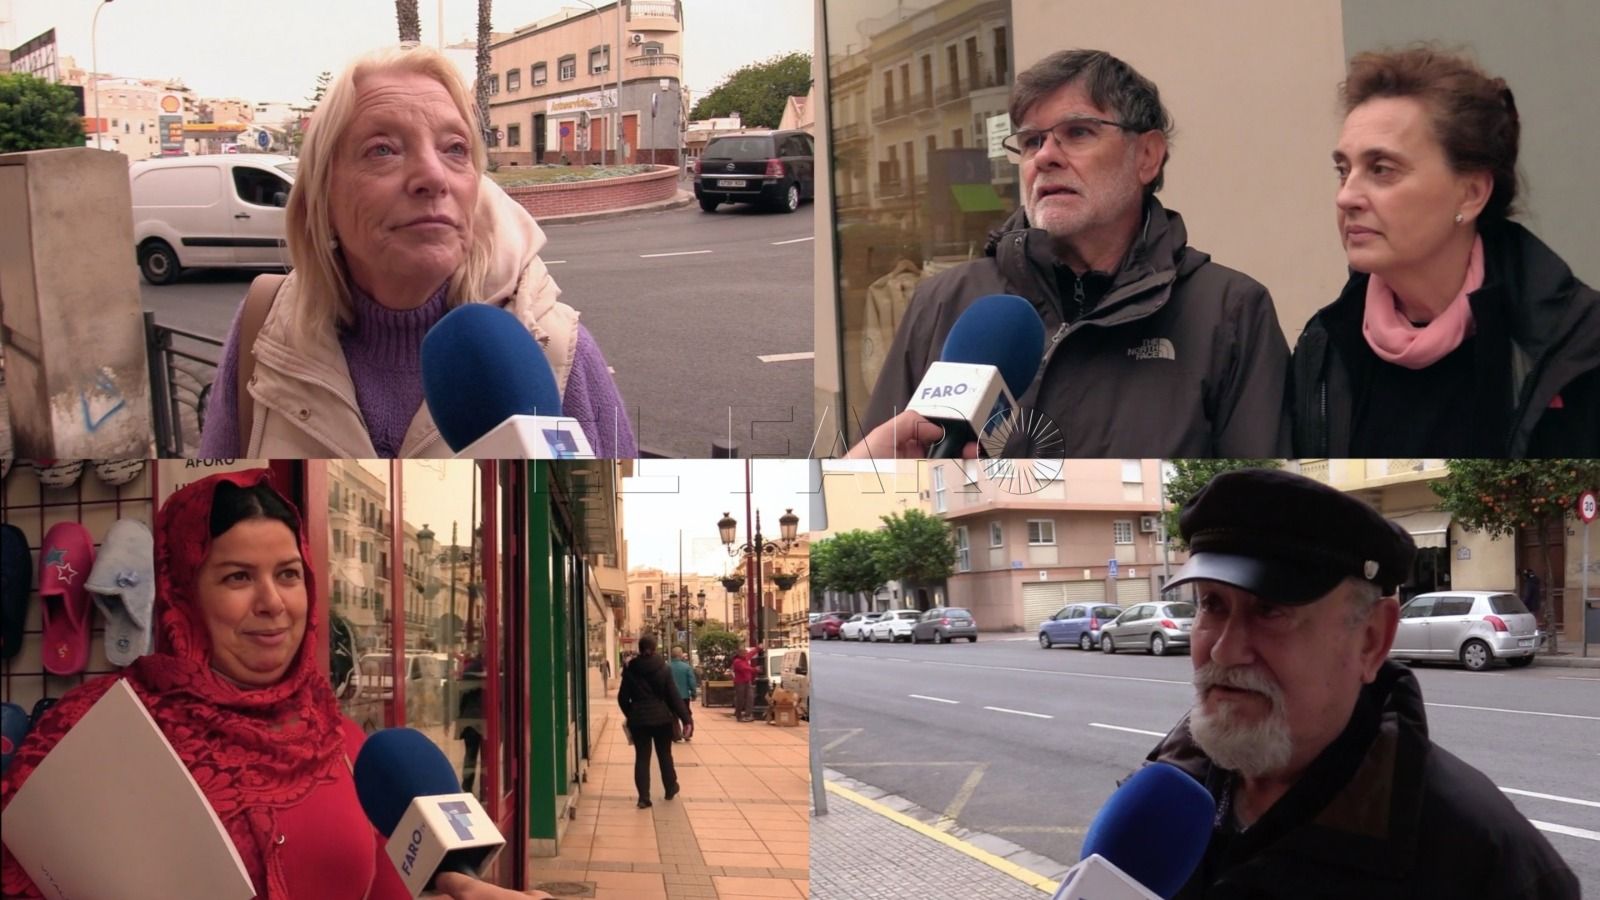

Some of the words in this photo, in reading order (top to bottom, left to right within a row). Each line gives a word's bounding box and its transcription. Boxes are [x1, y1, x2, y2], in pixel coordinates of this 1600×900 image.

[1142, 338, 1159, 347] THE
[1127, 345, 1159, 356] NORTH
[1135, 352, 1159, 360] FACE
[921, 383, 968, 400] FARO
[1584, 501, 1594, 512] 30
[401, 829, 423, 876] FARO
